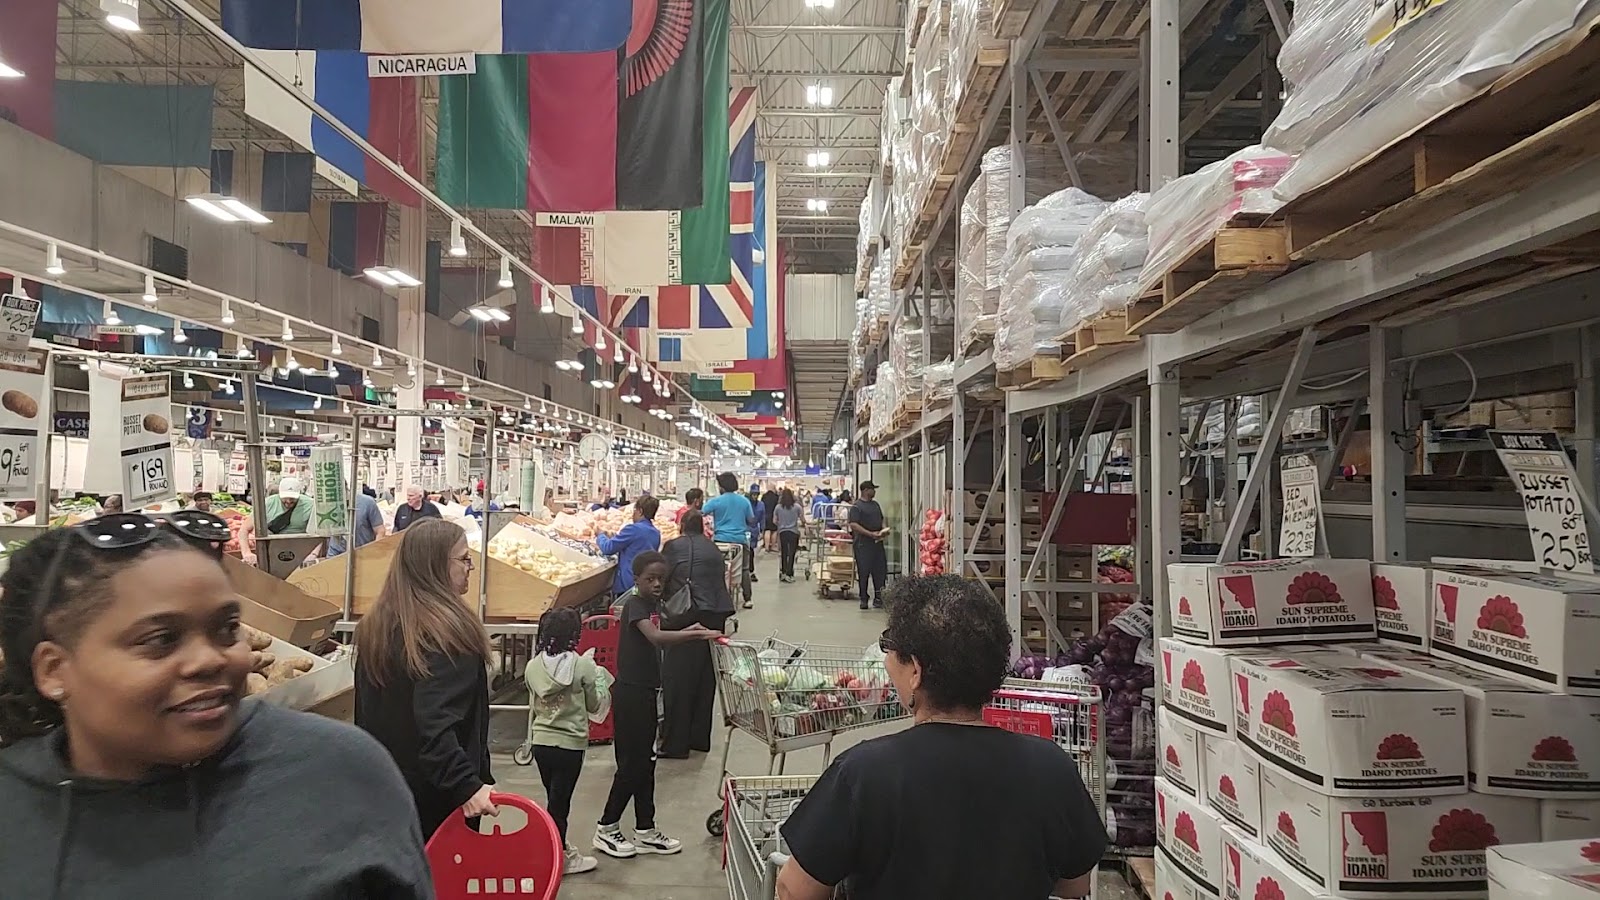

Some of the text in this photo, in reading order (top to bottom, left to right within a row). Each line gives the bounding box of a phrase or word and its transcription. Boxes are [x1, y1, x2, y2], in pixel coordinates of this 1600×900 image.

[377, 57, 468, 74] NICARAGUA
[549, 214, 594, 225] MALAWI
[624, 287, 642, 295] IRAN
[123, 414, 142, 425] RUSSET
[123, 424, 142, 436] POTATO
[1502, 435, 1548, 449] BOX PRICE
[1519, 473, 1569, 493] RUSSET
[1286, 488, 1300, 501] RED
[1285, 496, 1309, 513] ONION
[1525, 494, 1576, 515] POTATO
[1281, 604, 1349, 616] SUN SUPREME
[1224, 614, 1256, 627] IDAHO
[1276, 613, 1356, 625] IDAHO POTATOES
[1435, 626, 1455, 642] IDAHO
[1472, 630, 1532, 653] SUN SUPREME
[1467, 639, 1539, 666] IDAHO POTATOES
[1270, 729, 1301, 753] SUPREME
[1274, 742, 1307, 766] POTATOES
[1372, 760, 1426, 769] SUN SUPREME
[1395, 768, 1438, 777] POTATOES
[1514, 769, 1590, 780] IDAHO POTATOES
[1421, 855, 1448, 866] SUN
[1347, 863, 1386, 878] IDAHO
[1412, 868, 1455, 878] IDAHO
